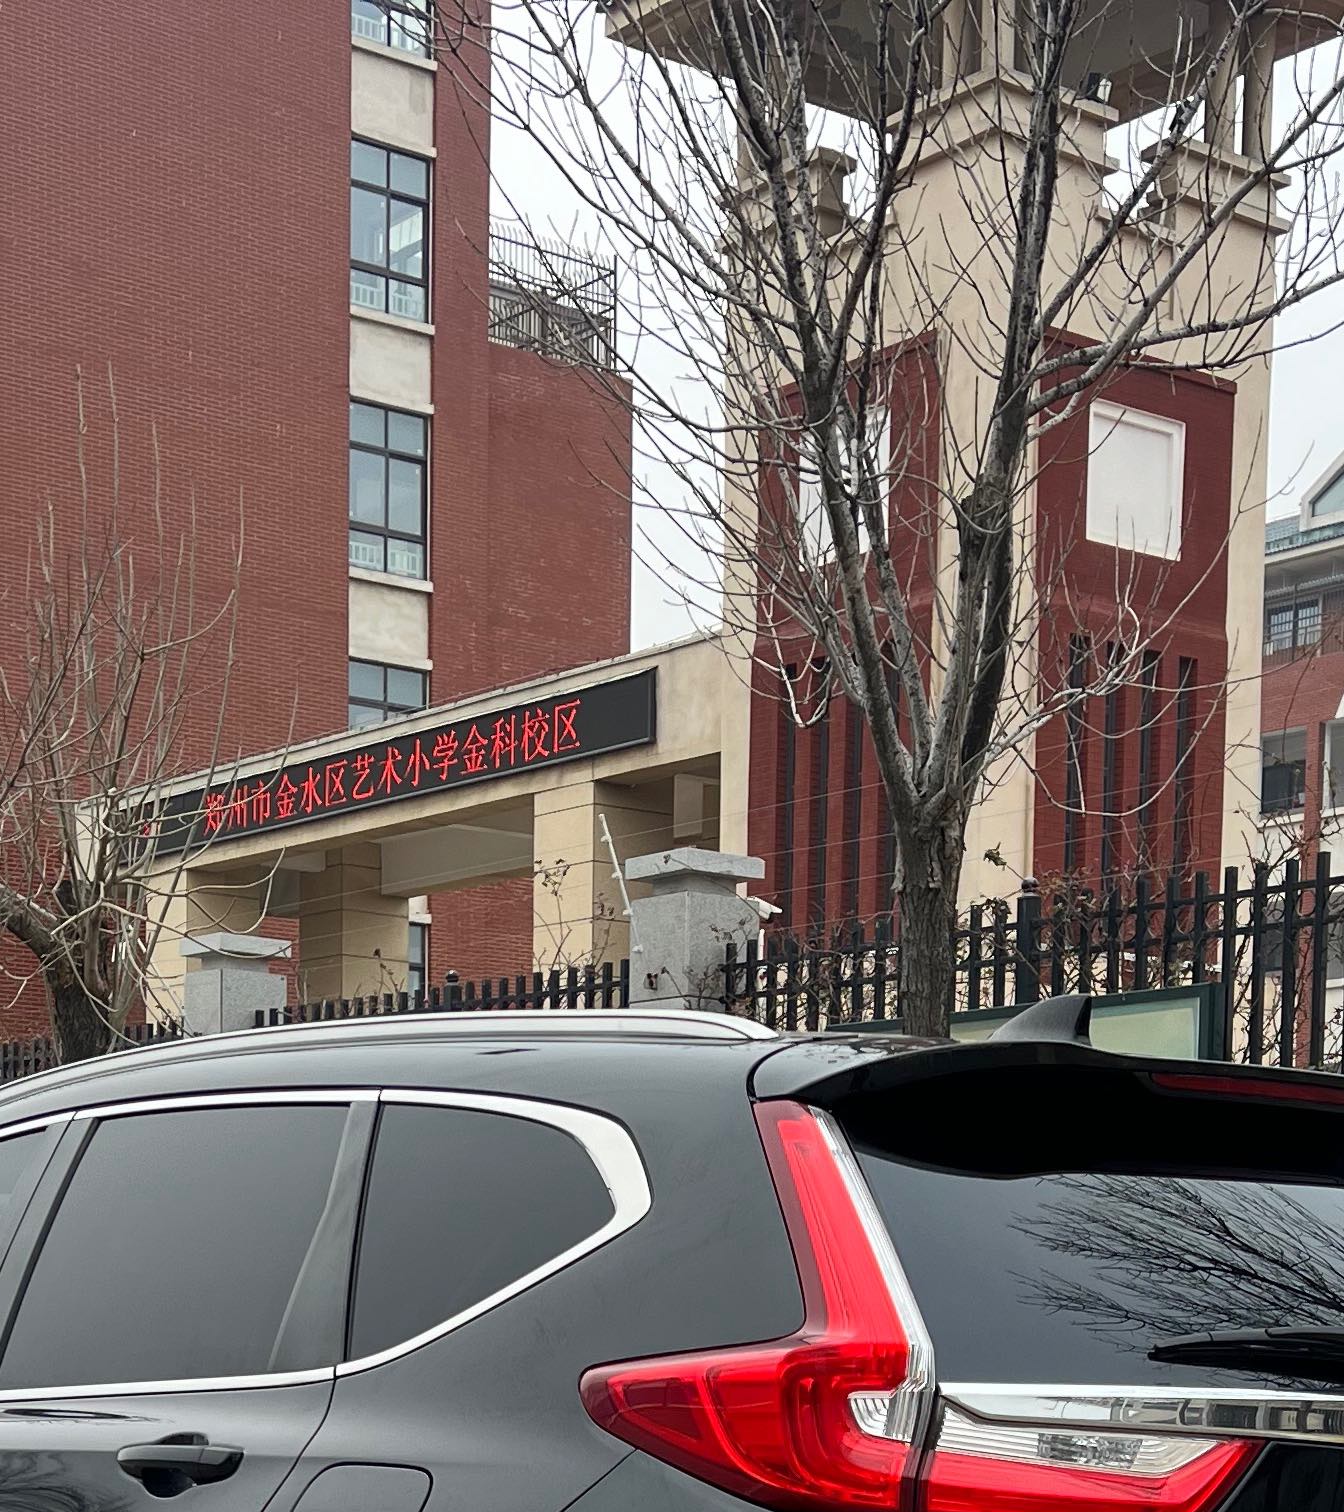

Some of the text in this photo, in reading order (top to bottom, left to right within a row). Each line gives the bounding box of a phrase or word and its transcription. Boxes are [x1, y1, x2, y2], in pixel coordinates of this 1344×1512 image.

[203, 699, 582, 836] 郑州市金水区艺术小学金科校区
